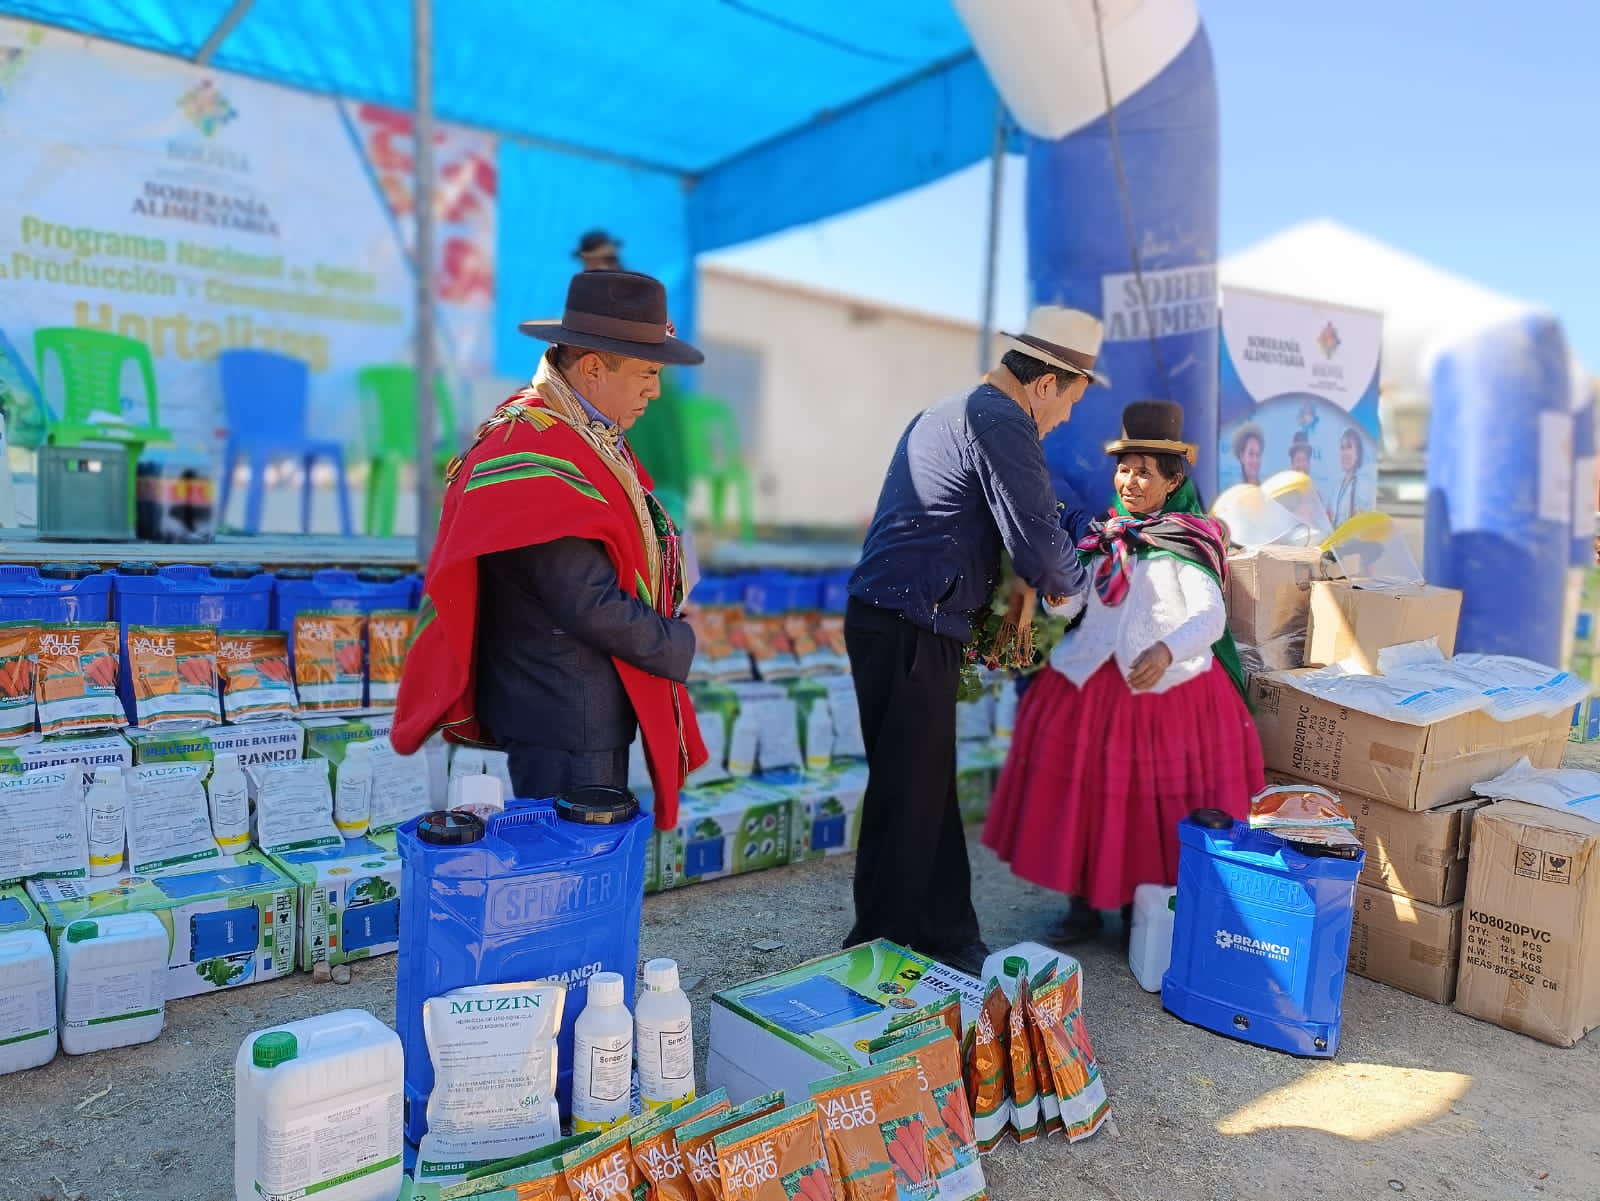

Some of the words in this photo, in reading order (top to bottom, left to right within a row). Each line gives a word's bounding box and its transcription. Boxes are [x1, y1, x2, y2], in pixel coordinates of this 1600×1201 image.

[131, 197, 280, 239] ALIMENTARIA
[21, 215, 167, 264] Programa
[10, 251, 177, 297] Producción
[39, 635, 80, 646] VALLE
[134, 638, 176, 649] VALLE
[220, 641, 253, 651] VALLE
[146, 738, 234, 757] PULVERIZADOR
[235, 738, 251, 748] DE
[252, 732, 298, 747] BATERIA
[1292, 705, 1310, 769] KD8020PVC
[238, 748, 297, 766] RANCO
[1, 773, 66, 789] MUZIN
[138, 765, 198, 779] MUZIN
[505, 874, 612, 922] SPRAYER
[1469, 909, 1552, 944] KD8020PVC
[1233, 934, 1290, 956] BRANCO
[1522, 940, 1543, 953] PCS
[1520, 961, 1542, 975] KGS
[1522, 951, 1543, 964] KGS
[536, 961, 602, 985] RANCO
[449, 994, 542, 1015] MUZIN
[819, 1089, 873, 1117] VALLE
[639, 1138, 681, 1167] VALL
[686, 1142, 718, 1167] VAL
[724, 1140, 775, 1174] VALLE
[573, 1151, 626, 1190] VALLE
